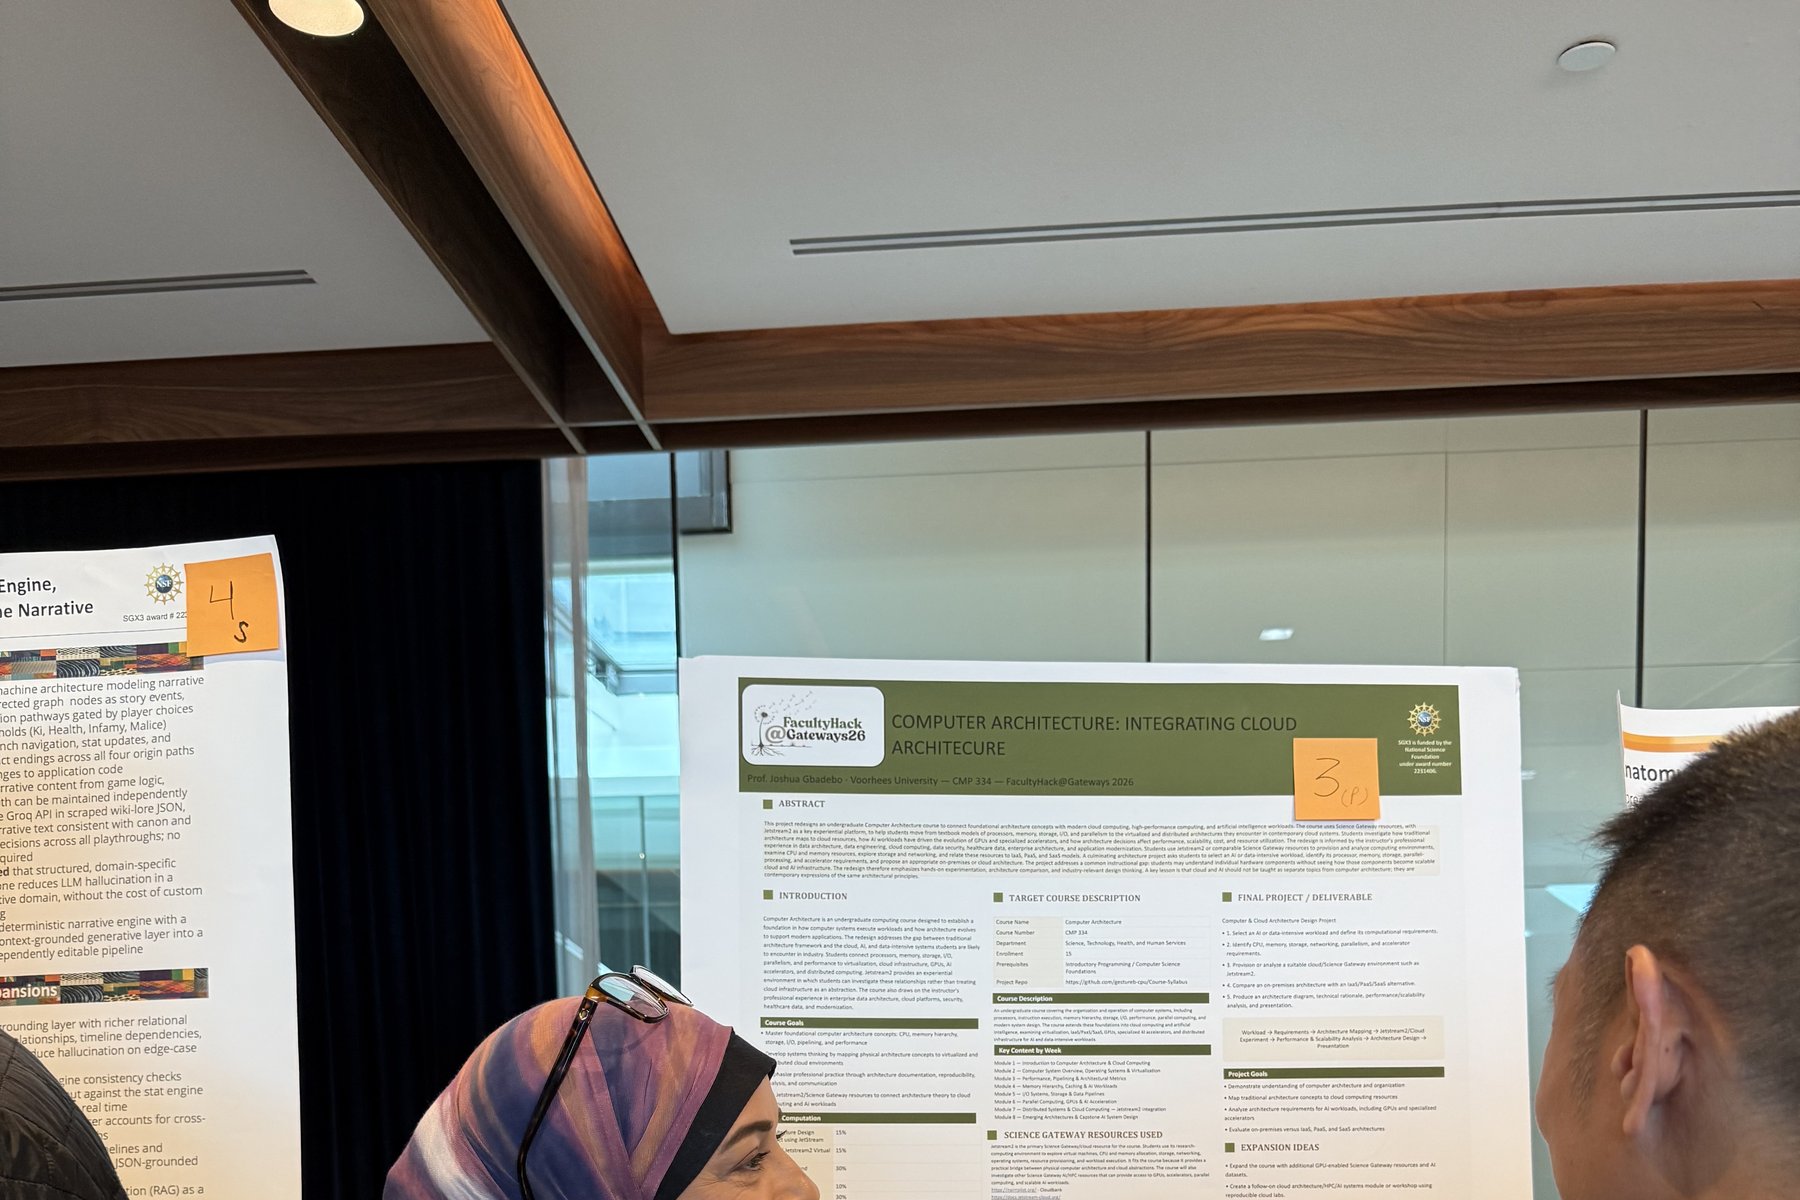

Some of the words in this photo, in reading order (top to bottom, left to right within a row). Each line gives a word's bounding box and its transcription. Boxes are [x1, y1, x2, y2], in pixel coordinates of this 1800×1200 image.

[0, 577, 56, 595] Engine,
[156, 580, 173, 589] NSF
[209, 580, 234, 620] 4
[18, 602, 94, 617] Narrative
[122, 614, 144, 622] SGX3
[169, 612, 174, 620] #
[0, 685, 38, 694] achine
[40, 683, 104, 694] architecture
[106, 679, 156, 691] modeling
[158, 676, 204, 687] narrative
[32, 697, 64, 710] graph
[69, 696, 102, 705] nodes
[119, 695, 146, 707] story
[149, 692, 184, 702] events,
[19, 712, 70, 725] pathways
[72, 709, 102, 722] gated
[105, 708, 118, 721] by
[120, 708, 153, 720] player
[155, 705, 194, 715] choices
[891, 714, 986, 729] COMPUTER
[990, 716, 1119, 730] ARCHITECTURE:
[1125, 716, 1235, 730] INTEGRATING
[1240, 716, 1297, 731] CLOUD
[29, 726, 45, 738] (Ki,
[48, 724, 86, 735] Health,
[88, 723, 127, 734] Infamy,
[130, 720, 166, 731] Malice)
[783, 716, 862, 730] FacultyHack
[765, 725, 866, 744] @Gateways26
[891, 740, 1005, 755] ARCHITECURE
[12, 754, 55, 766] endings
[57, 753, 91, 762] across
[93, 750, 106, 761] all
[108, 750, 131, 760] four
[132, 747, 162, 760] origin
[165, 746, 194, 759] paths
[747, 774, 767, 782] Prof.
[769, 775, 800, 783] Joshua
[802, 775, 843, 784] Gbadebo
[849, 776, 892, 784] Voorhees
[894, 776, 938, 786] University
[952, 776, 973, 785] CMP
[974, 776, 992, 786] 334
[1006, 777, 1110, 787] FacultyHack@Gateways
[1111, 777, 1134, 786] 2026
[1314, 758, 1340, 797] 3
[779, 892, 847, 900] INTRODUCTION
[1265, 894, 1304, 902] PROJECT
[0, 984, 58, 998] ansions
[1018, 995, 1053, 1003] Description
[51, 1020, 76, 1031] layer
[78, 1018, 102, 1028] with
[104, 1017, 135, 1028] richer
[137, 1015, 187, 1026] relational
[83, 1074, 144, 1085] consistency
[145, 1071, 182, 1082] checks
